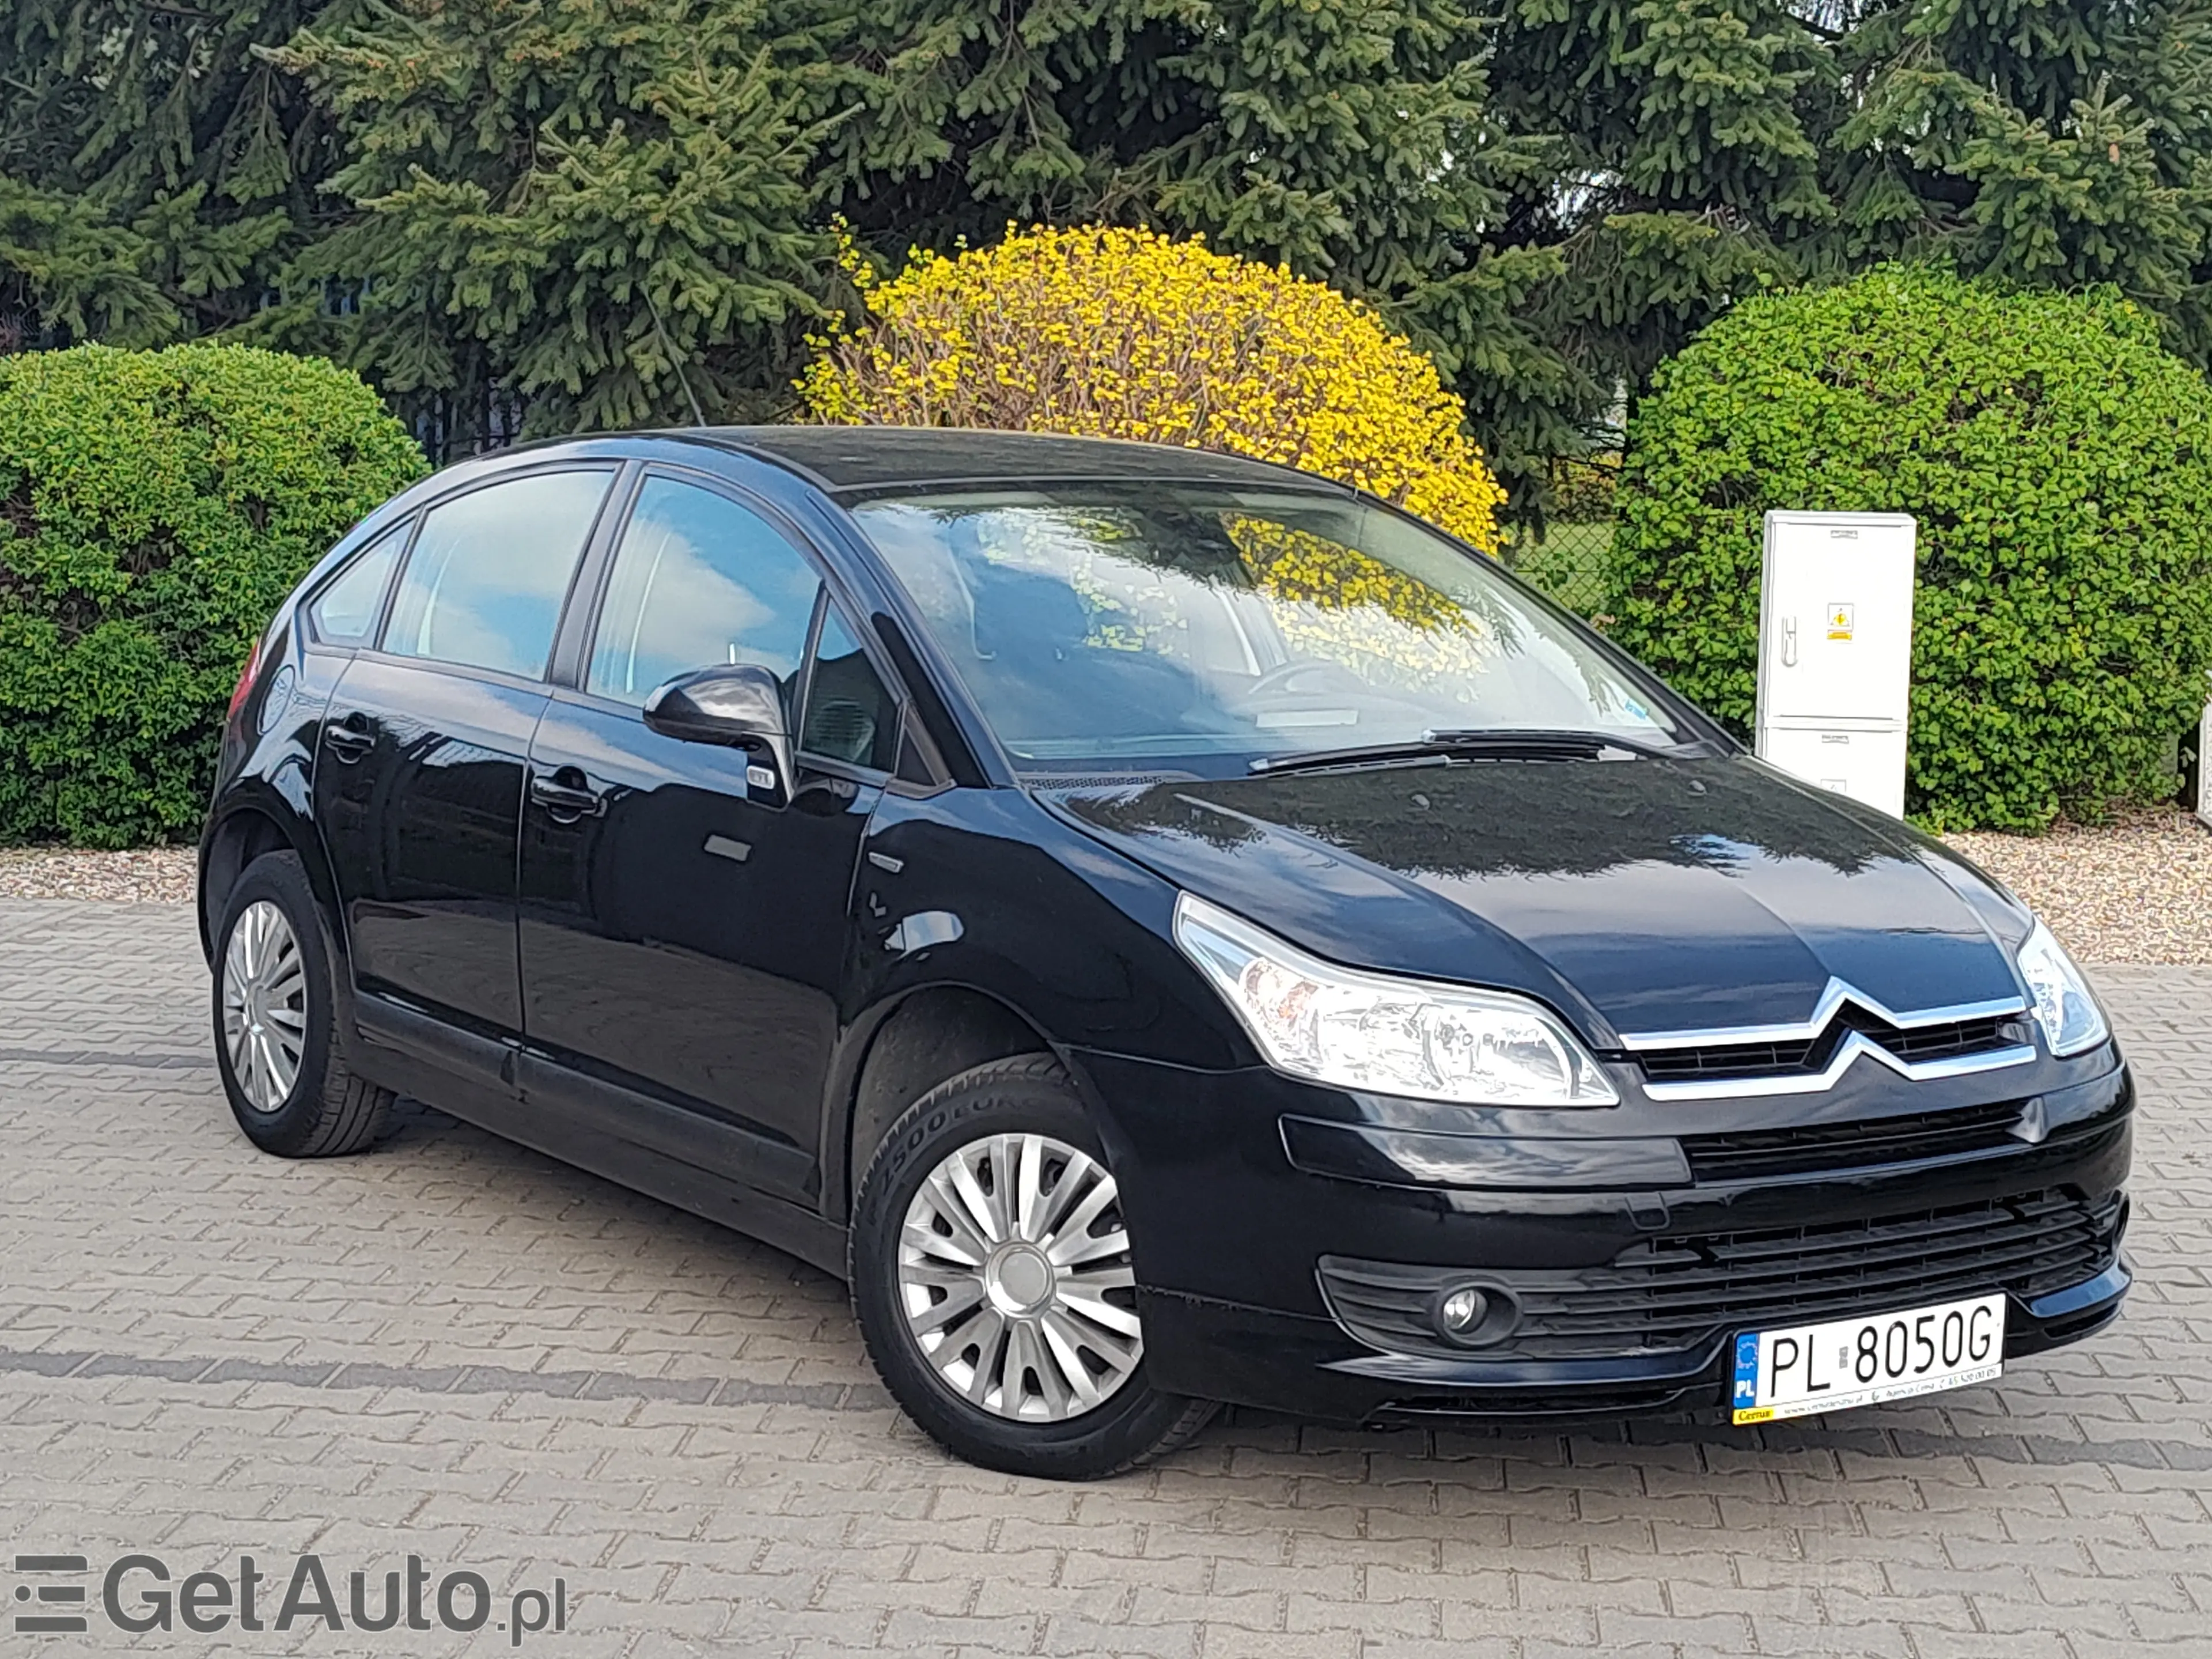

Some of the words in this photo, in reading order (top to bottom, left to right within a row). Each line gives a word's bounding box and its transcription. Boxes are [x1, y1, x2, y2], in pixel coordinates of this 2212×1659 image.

[1770, 1334, 1831, 1398] PL
[1854, 1305, 1993, 1383] 8050G
[1736, 1380, 1755, 1399] PL
